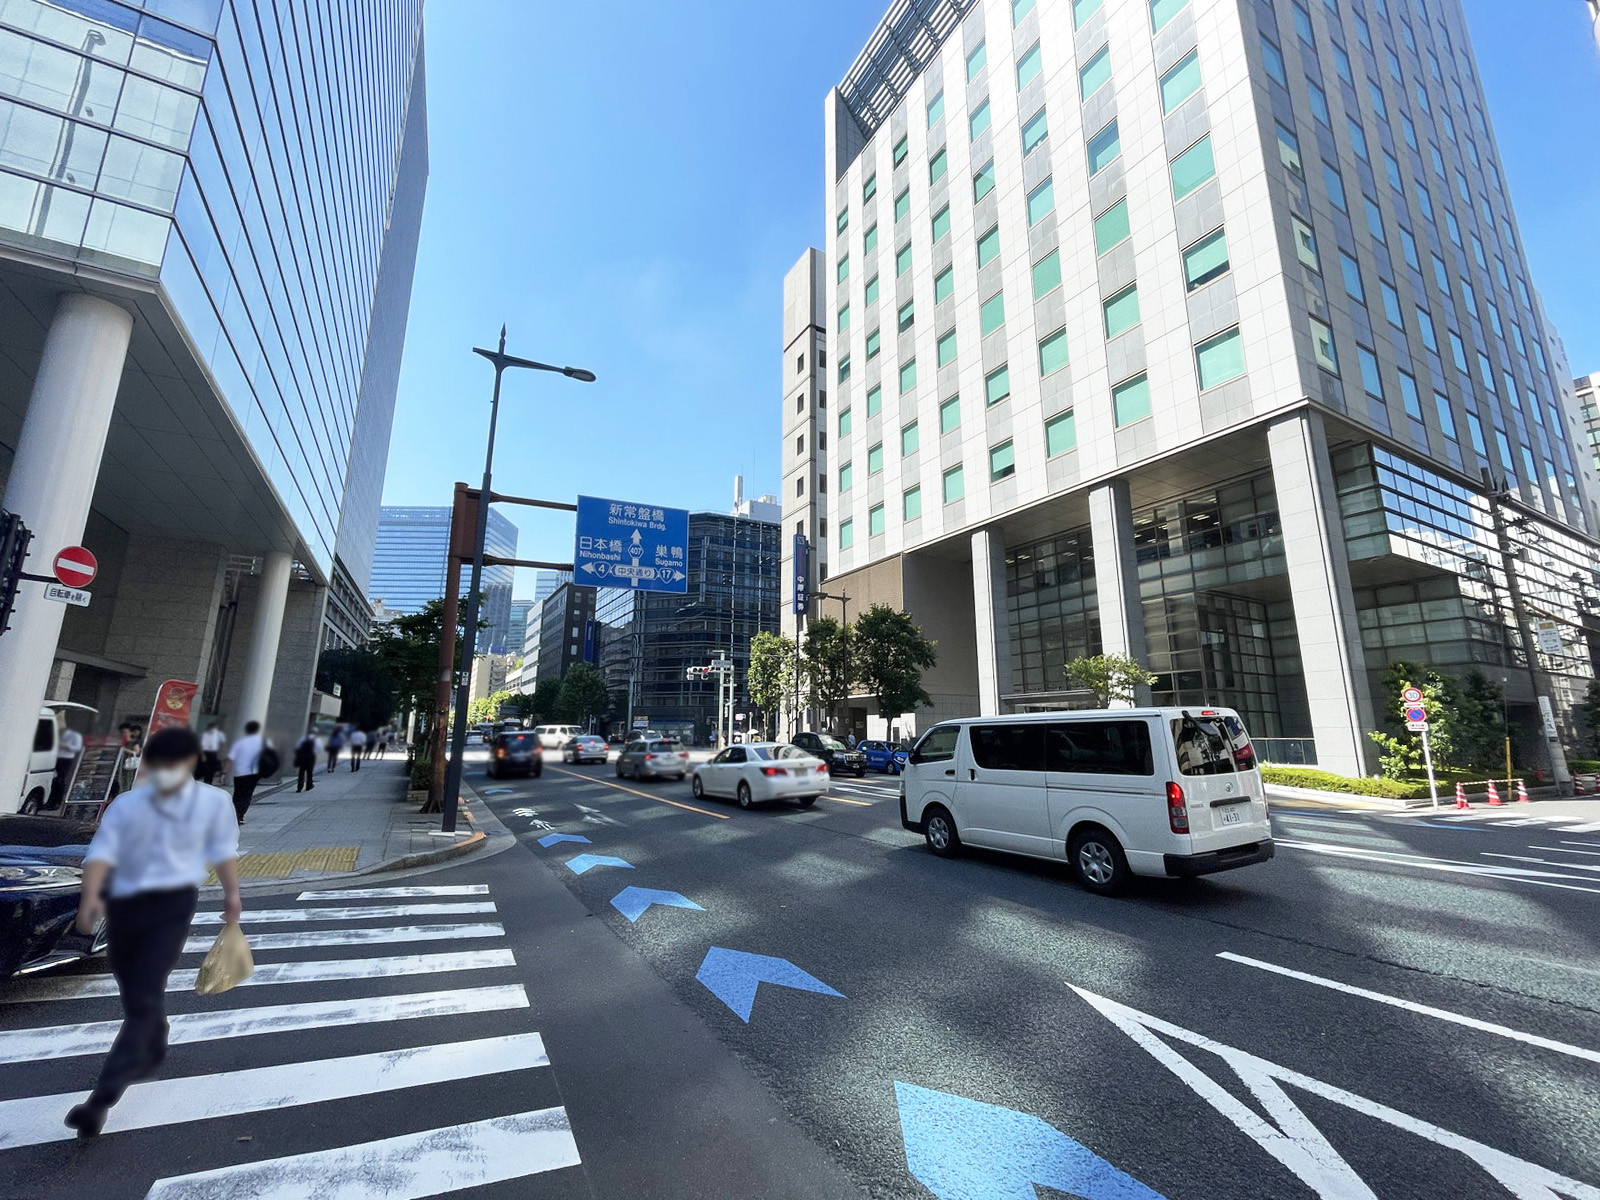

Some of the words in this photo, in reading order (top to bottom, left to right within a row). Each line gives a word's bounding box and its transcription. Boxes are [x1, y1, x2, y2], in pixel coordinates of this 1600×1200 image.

[609, 503, 665, 522] 新常盤橋
[608, 517, 647, 528] Shintokiwa
[649, 521, 666, 531] Brdg.
[580, 536, 623, 553] 日本橋
[580, 550, 621, 561] Nihonbashi
[630, 546, 642, 555] 407
[655, 544, 683, 560] 巣鴨
[655, 557, 683, 568] Sugamo
[598, 564, 605, 573] 4
[617, 567, 652, 577] 中央通り
[661, 569, 672, 579] 17
[1407, 691, 1418, 700] 30
